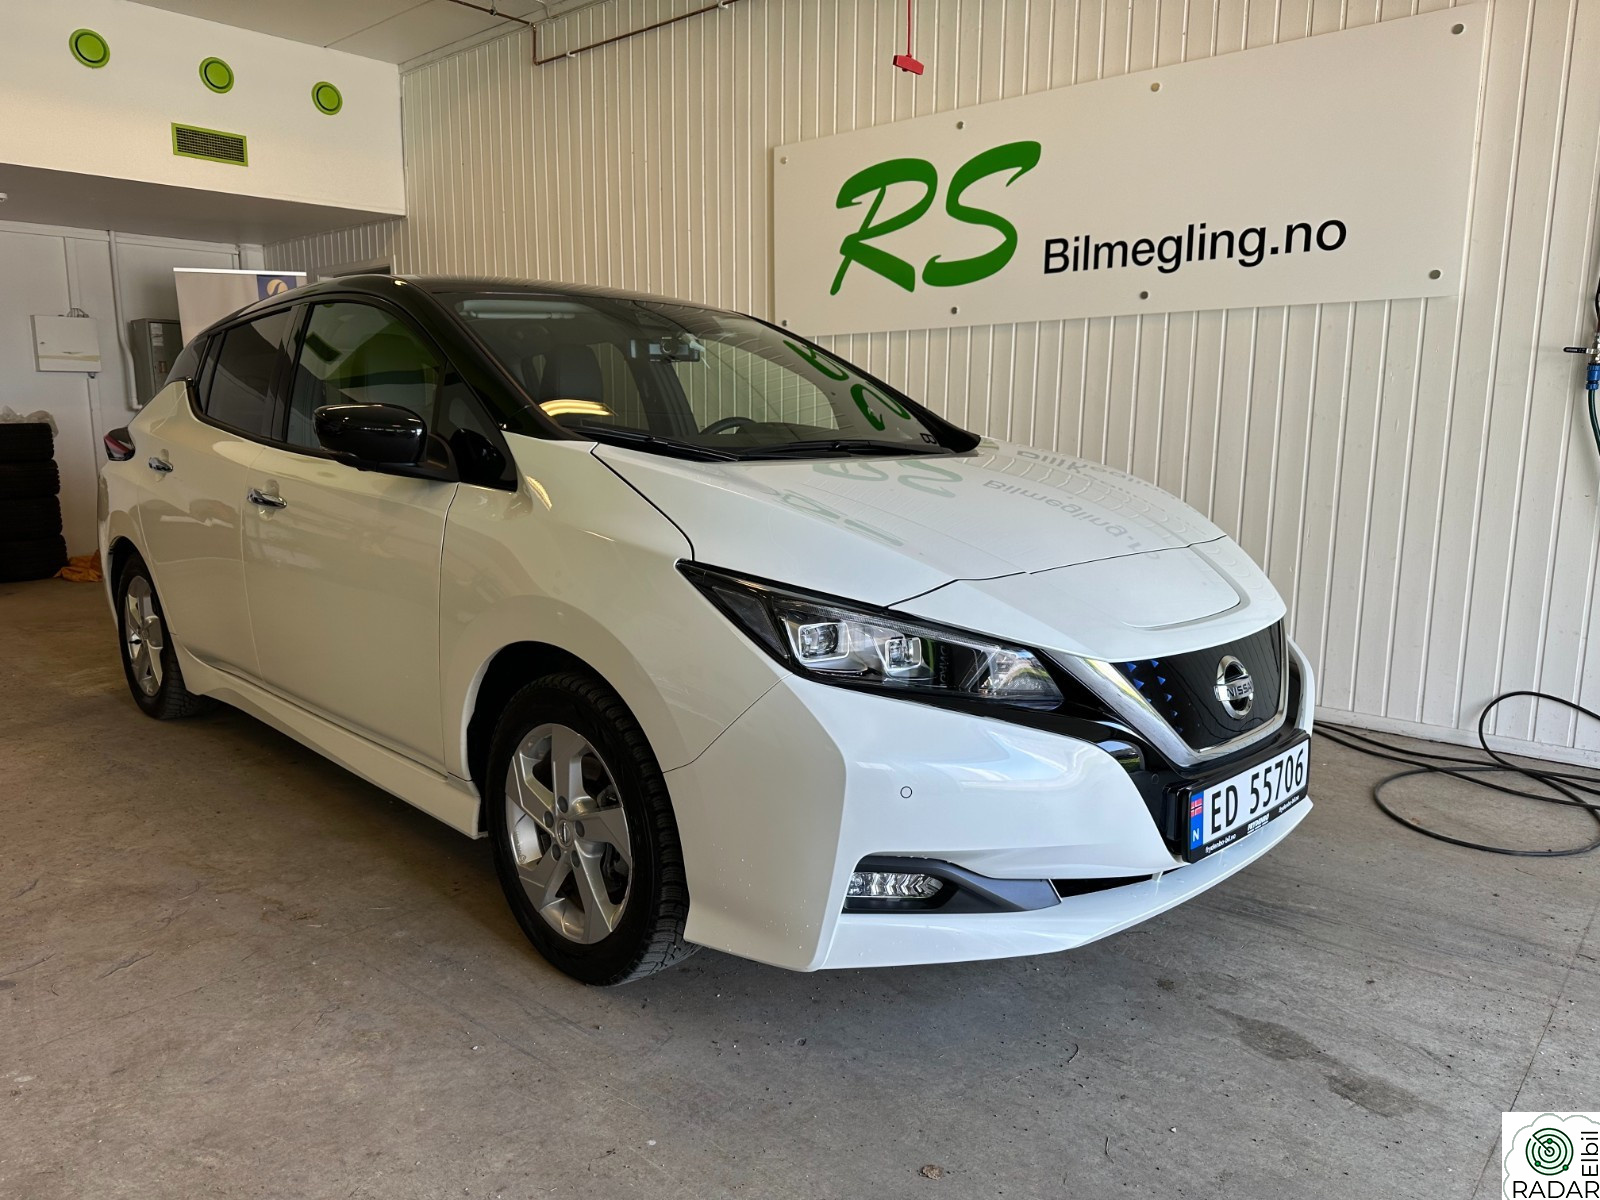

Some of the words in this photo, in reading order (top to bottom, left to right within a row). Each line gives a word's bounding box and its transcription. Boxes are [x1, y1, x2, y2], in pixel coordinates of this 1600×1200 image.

[830, 140, 1041, 295] RS
[1044, 219, 1347, 275] Bilmegling.no
[1192, 828, 1200, 842] N
[1211, 784, 1239, 835] ED
[1250, 748, 1304, 815] 55706
